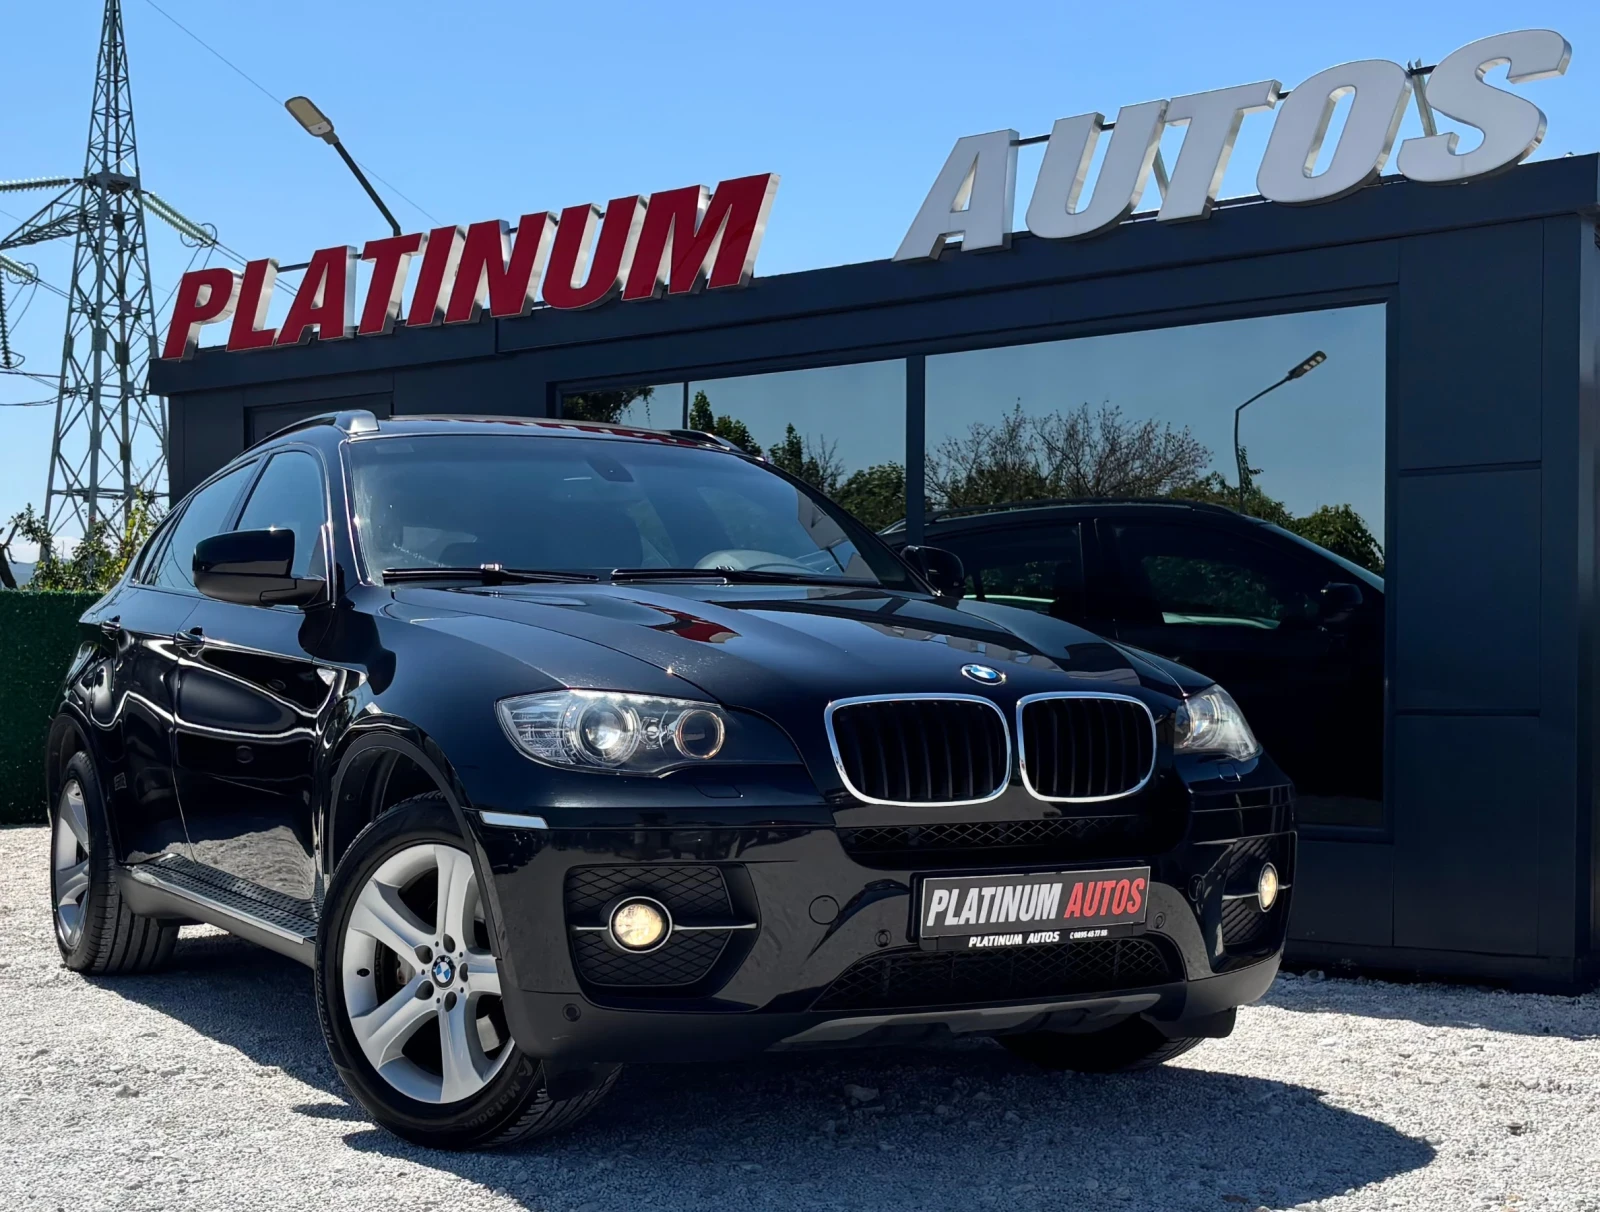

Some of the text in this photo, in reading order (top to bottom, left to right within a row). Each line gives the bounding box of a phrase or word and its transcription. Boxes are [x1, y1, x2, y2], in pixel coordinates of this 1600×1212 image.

[161, 29, 1572, 361] PLATINUM AUTOS
[926, 877, 1145, 927] PLATINUM AUTOS
[968, 933, 1023, 948] PLATINUM
[1026, 931, 1061, 945] AUTOS
